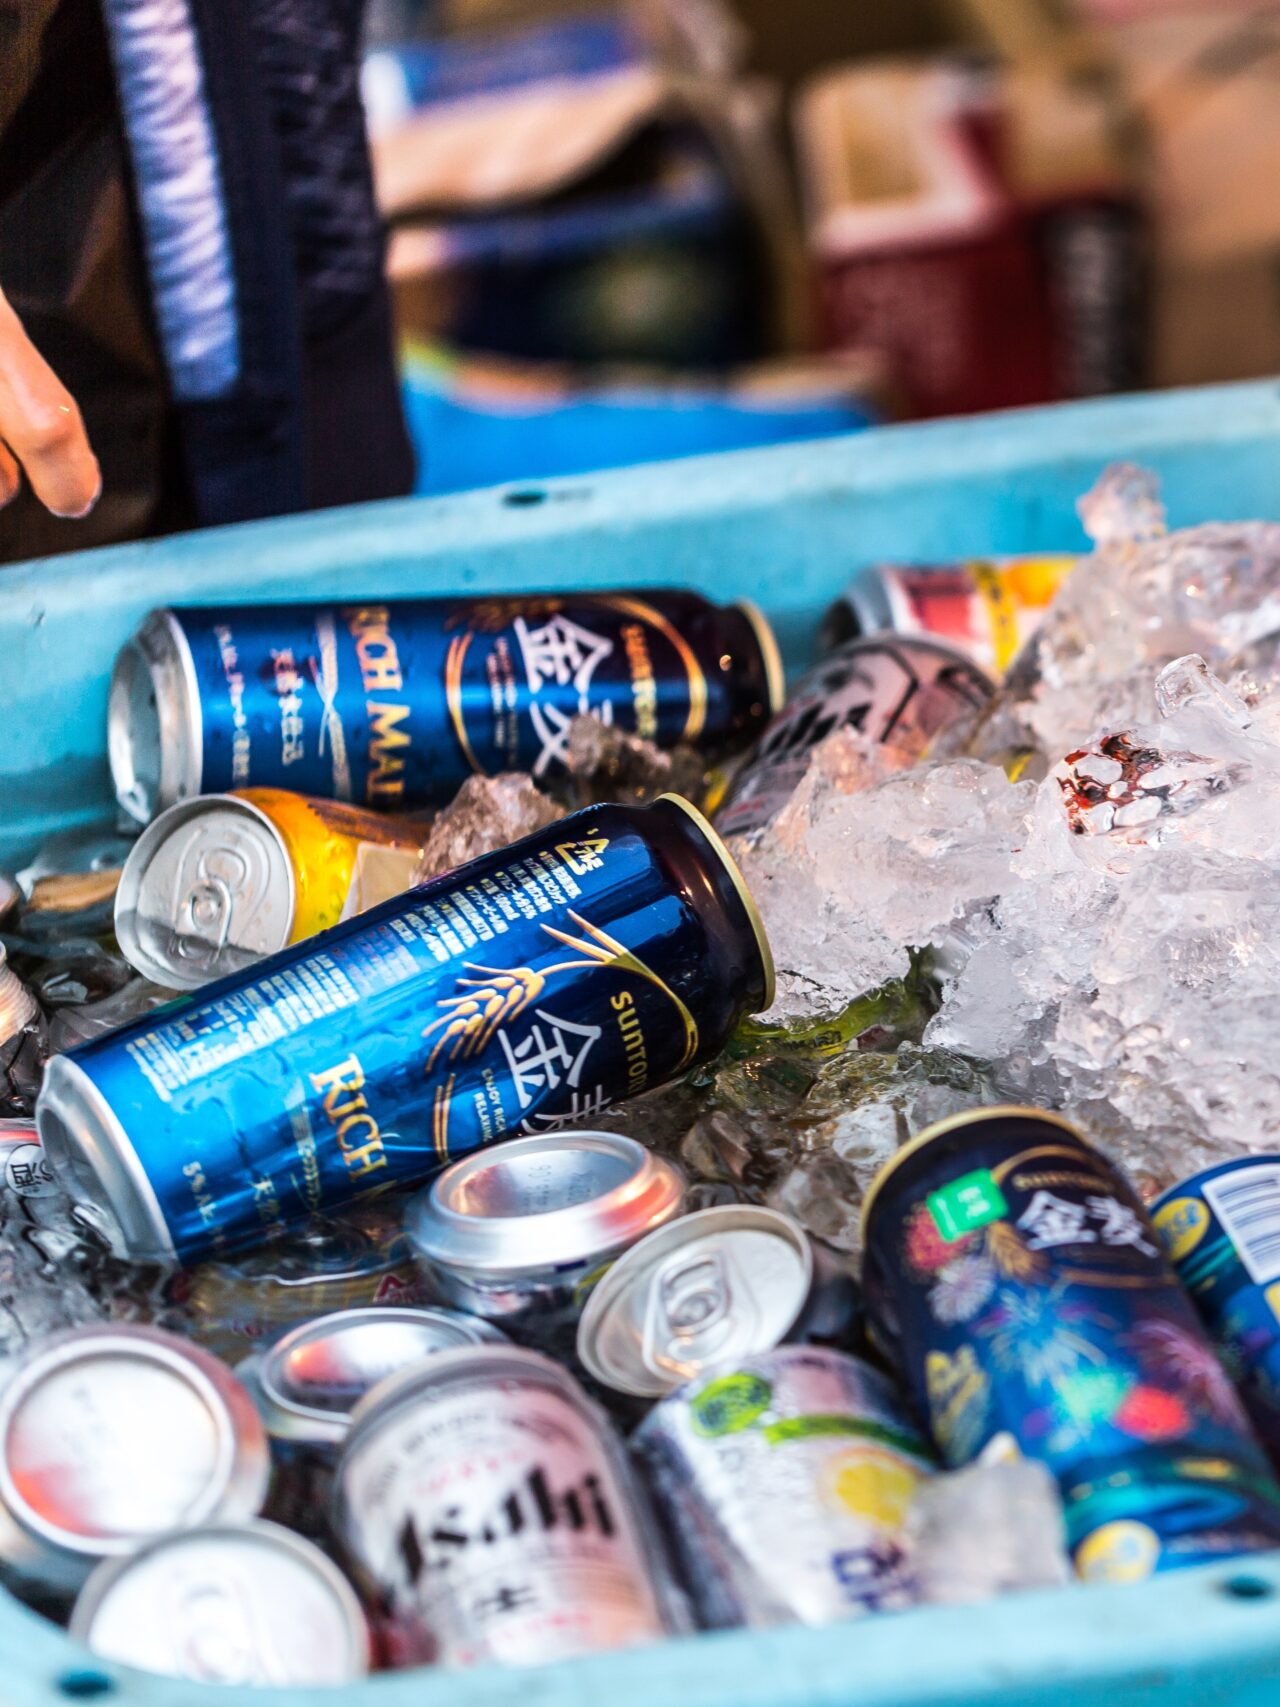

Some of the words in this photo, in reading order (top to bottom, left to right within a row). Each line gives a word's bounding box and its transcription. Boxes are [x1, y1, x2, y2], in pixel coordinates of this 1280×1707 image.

[610, 990, 651, 1095] SUNTOR
[309, 1053, 388, 1180] RICH
[1015, 1189, 1160, 1259] 金麦
